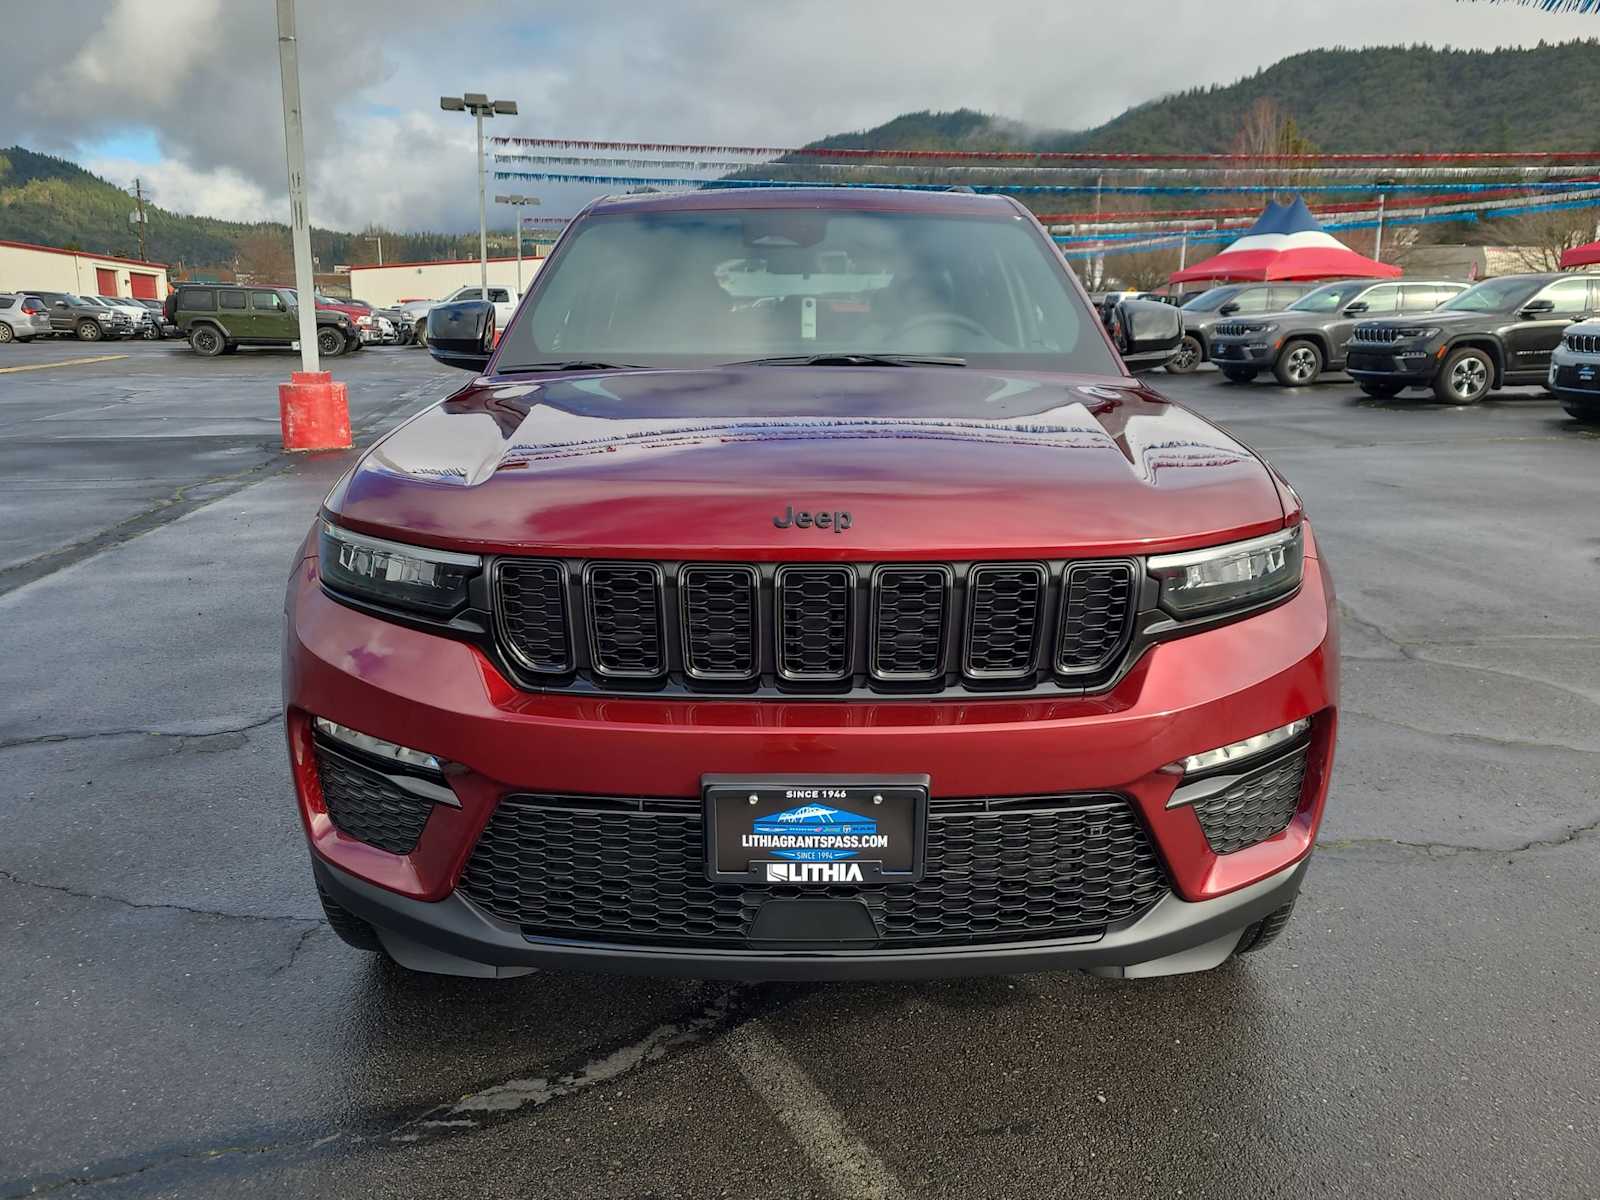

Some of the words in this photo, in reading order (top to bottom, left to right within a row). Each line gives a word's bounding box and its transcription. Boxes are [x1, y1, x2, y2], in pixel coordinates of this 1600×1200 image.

[773, 506, 853, 534] Jeep
[786, 790, 819, 799] SINCE
[822, 790, 847, 799] 1946
[742, 834, 888, 848] LITHIAGRANTSPASS.COM
[796, 851, 816, 860] SINCE
[789, 863, 864, 882] LITHIA
